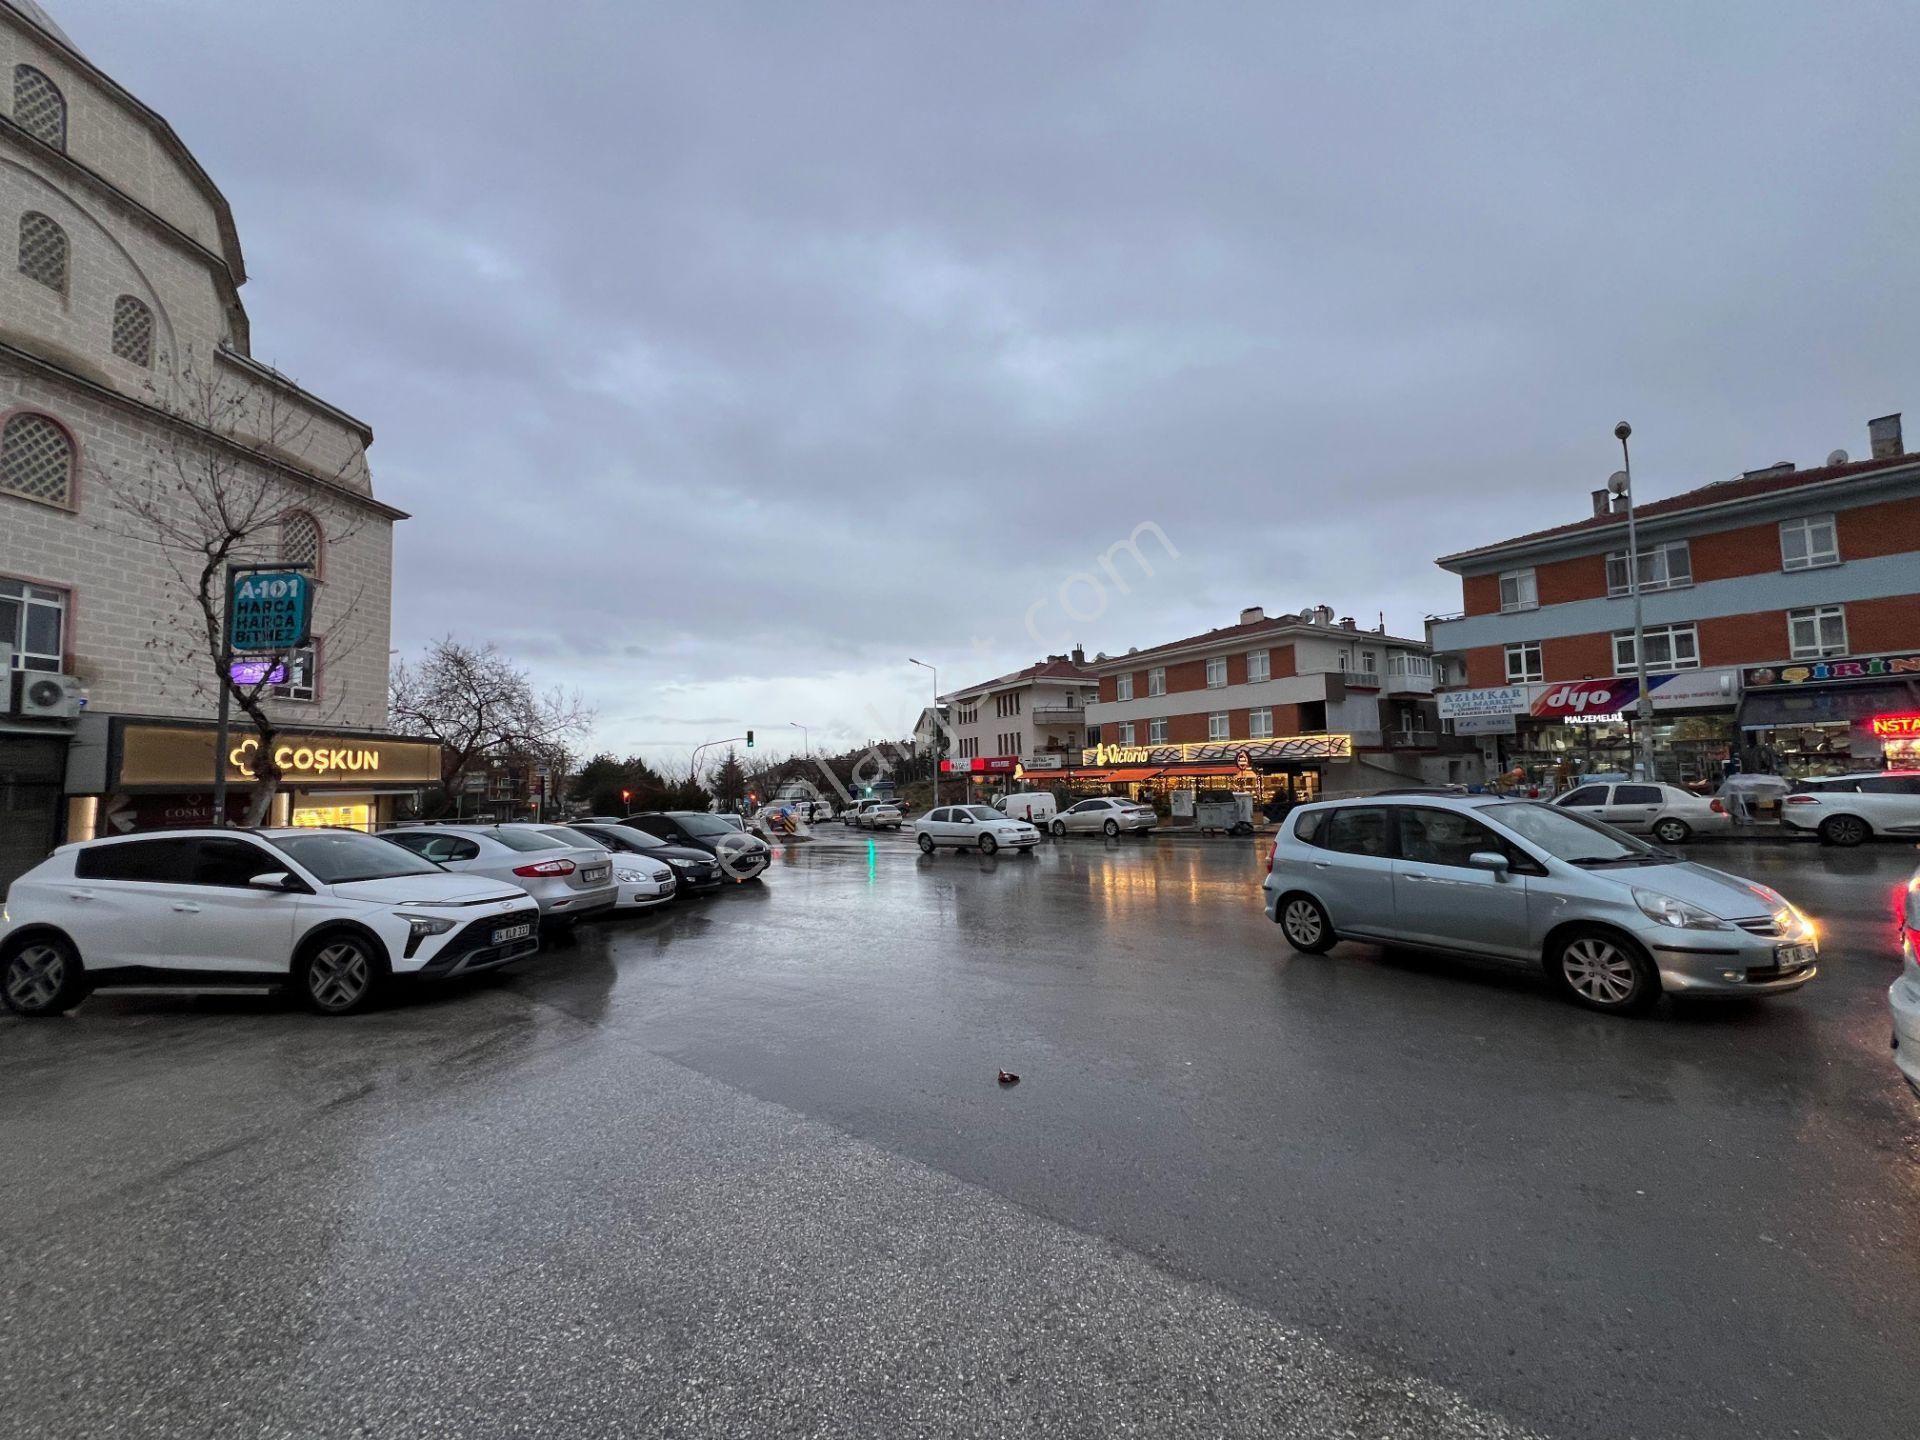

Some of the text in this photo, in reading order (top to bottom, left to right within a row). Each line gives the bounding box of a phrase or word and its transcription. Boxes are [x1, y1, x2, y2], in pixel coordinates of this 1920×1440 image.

[237, 600, 297, 615] HARCA
[236, 615, 295, 629] HARCA
[1547, 686, 1612, 712] dyo
[273, 746, 380, 774] COŞKUN
[1107, 742, 1149, 764] Victoria
